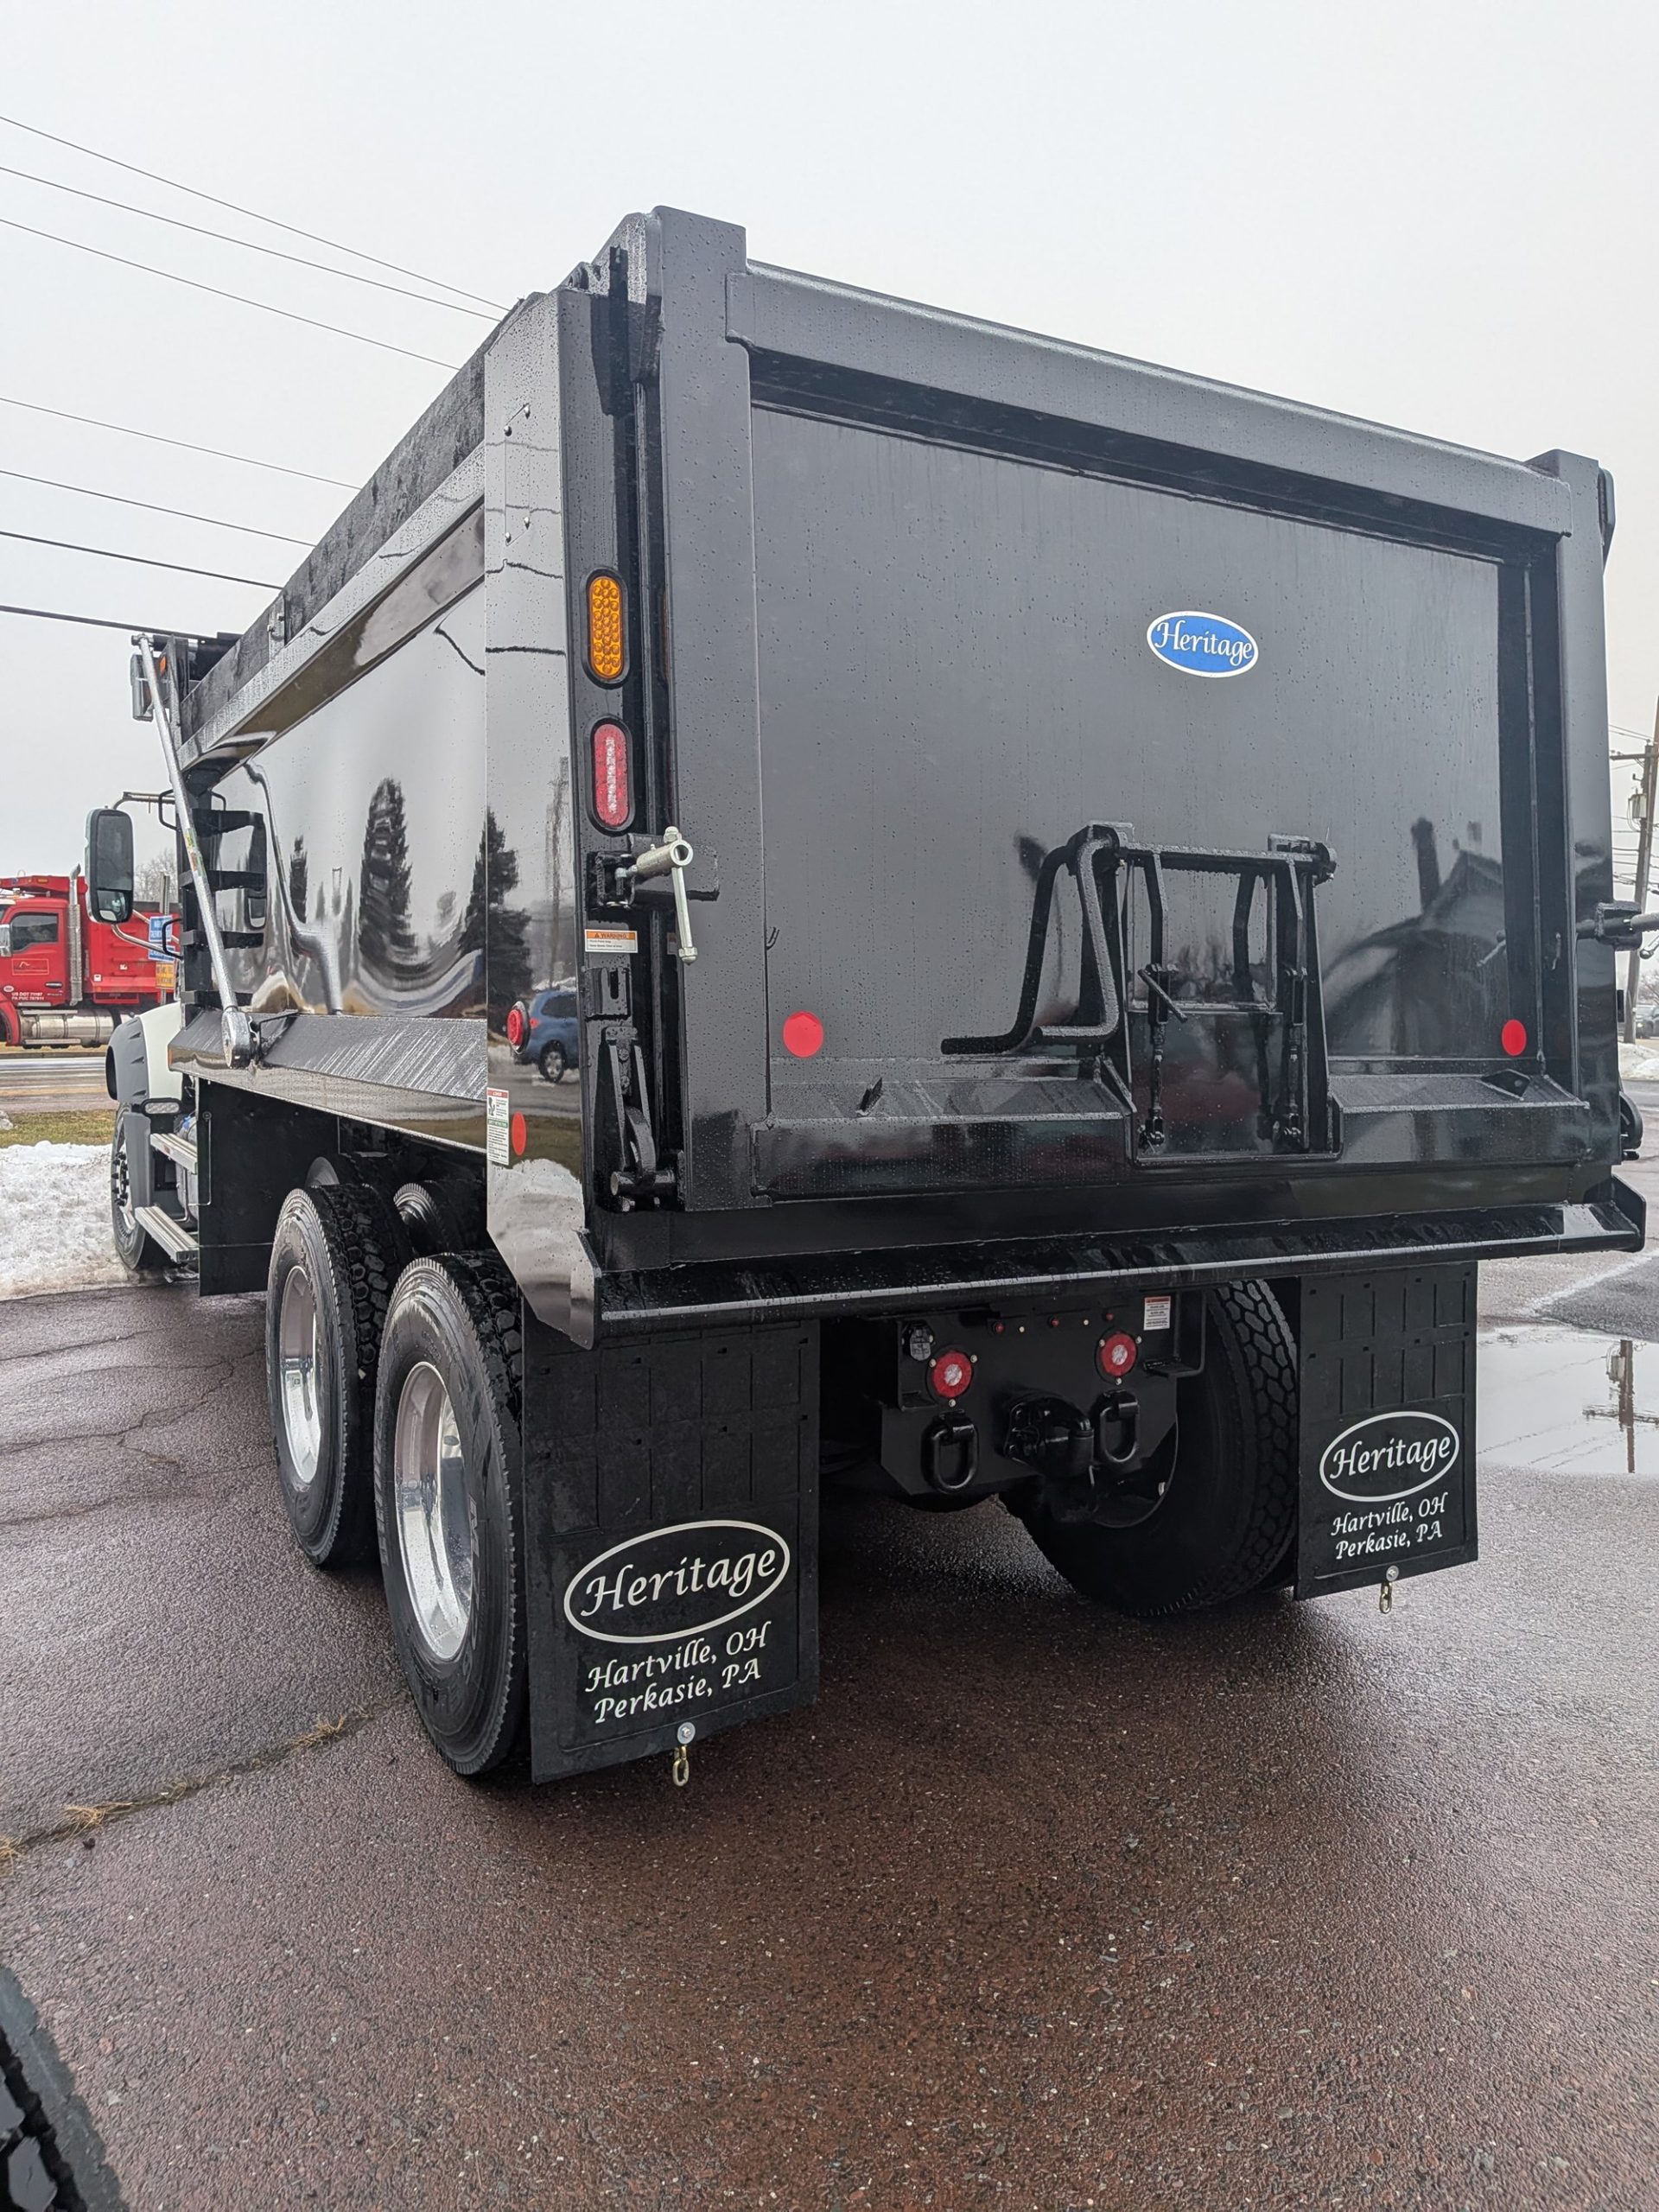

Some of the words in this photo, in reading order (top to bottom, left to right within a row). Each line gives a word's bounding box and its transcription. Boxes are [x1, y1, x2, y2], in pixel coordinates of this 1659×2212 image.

[1154, 620, 1253, 666] Heritage
[1329, 1436, 1452, 1479] Heritage
[1331, 1501, 1414, 1536] Hartville,
[1418, 1491, 1449, 1518] OH
[1335, 1529, 1412, 1560] Perkasie,
[1415, 1520, 1443, 1543] PA
[580, 1549, 777, 1618] Heritage
[584, 1637, 717, 1693] Hartville,
[726, 1621, 772, 1656] OH
[594, 1675, 713, 1724] Perkasie,
[721, 1657, 761, 1689] PA
